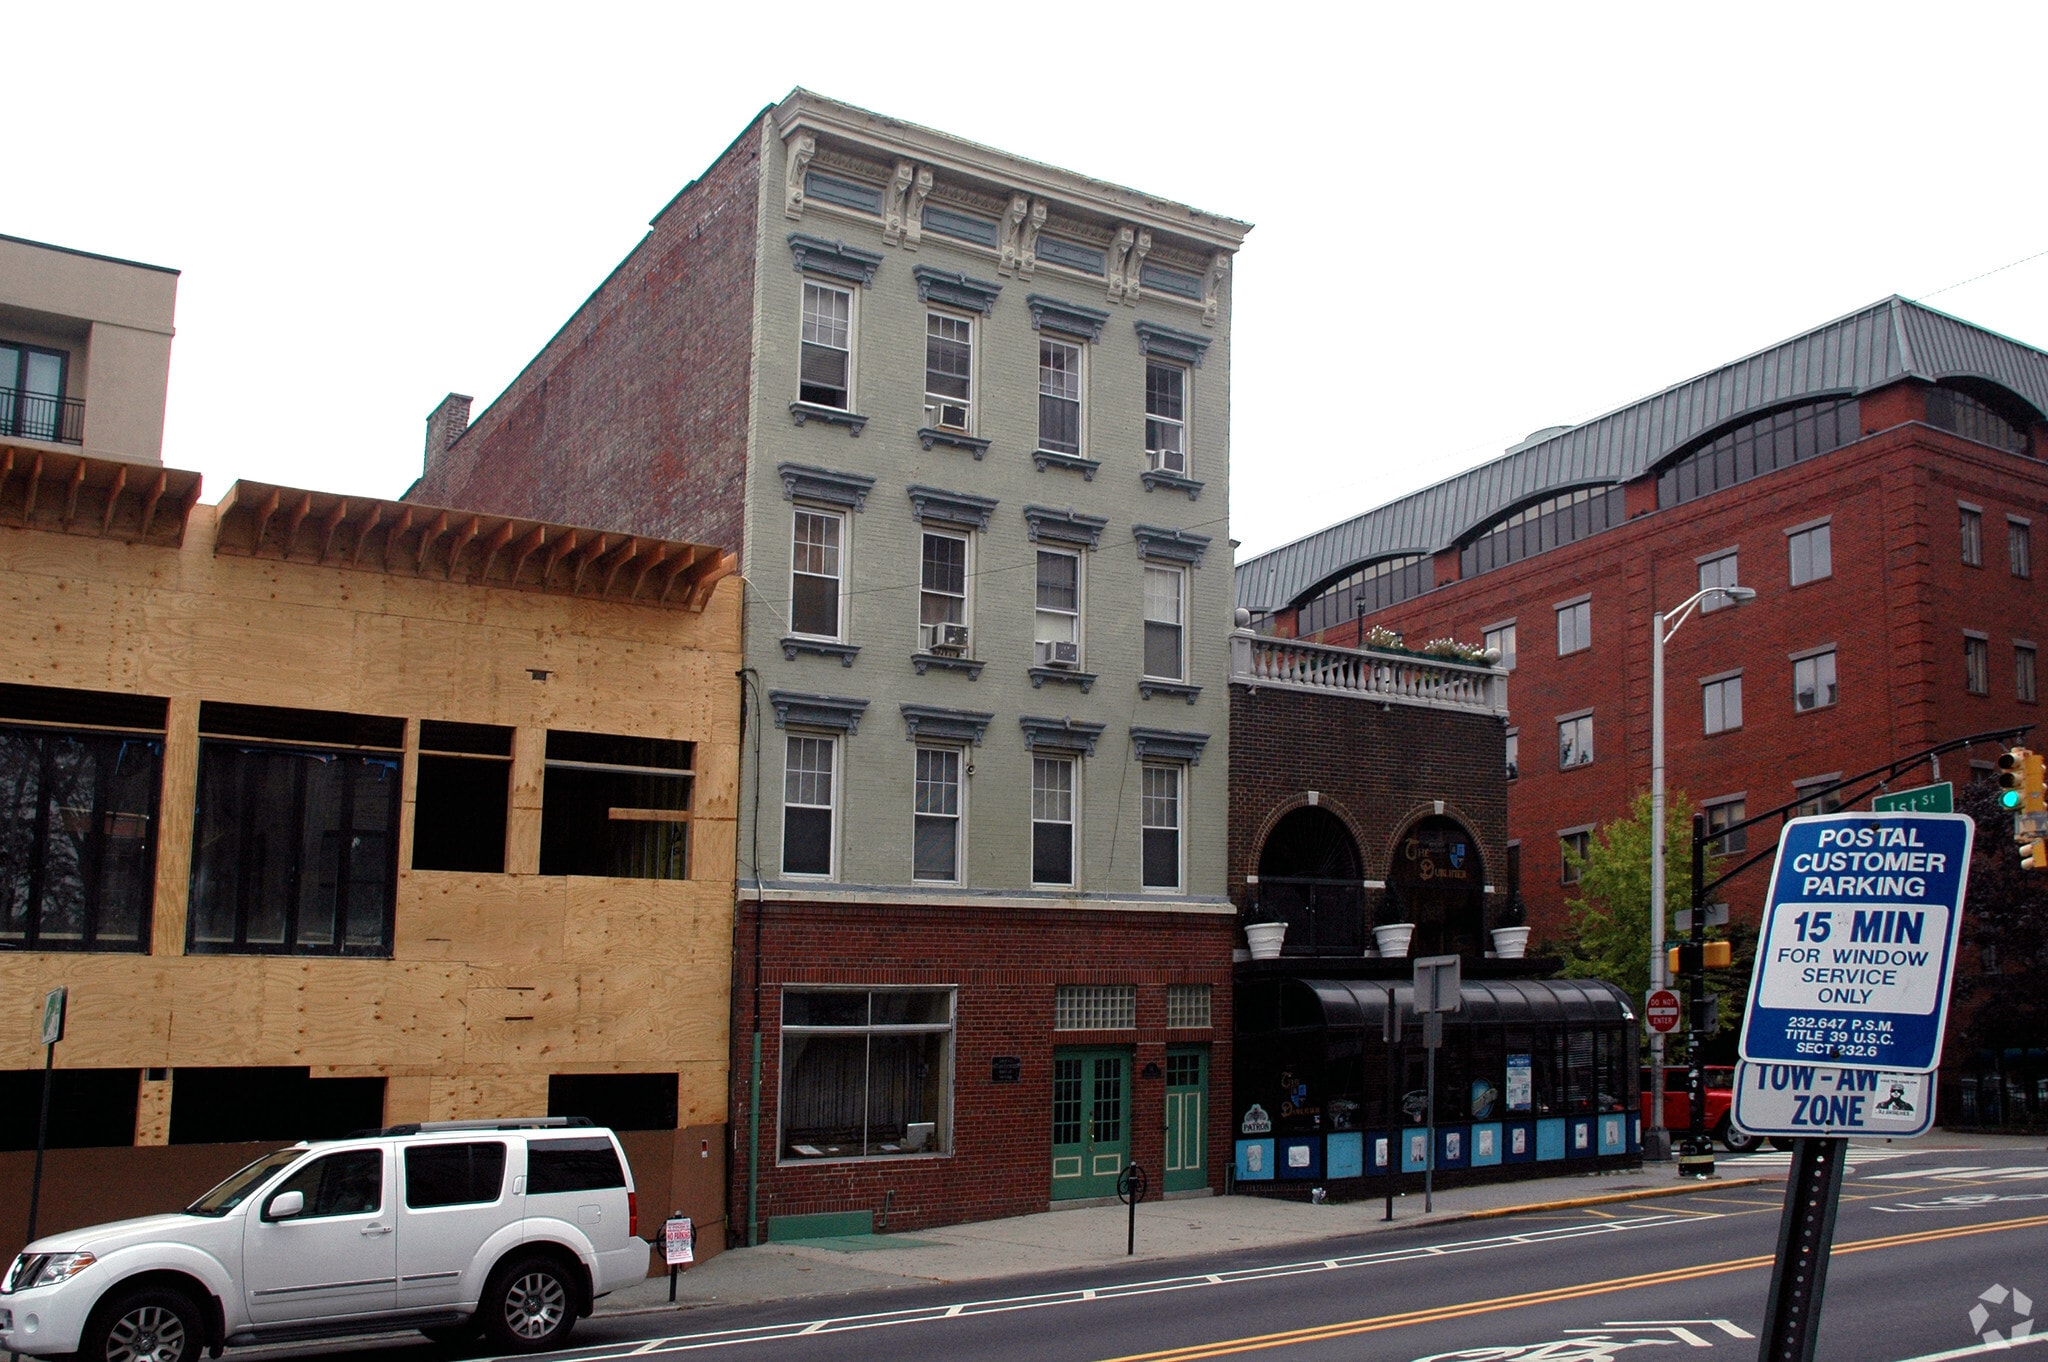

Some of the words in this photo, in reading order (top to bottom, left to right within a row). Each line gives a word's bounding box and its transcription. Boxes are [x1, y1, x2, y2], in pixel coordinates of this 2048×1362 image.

[1889, 798, 1917, 812] 1st
[1921, 794, 1935, 806] St
[1818, 827, 1925, 848] POSTAL
[1792, 852, 1947, 873] CUSTOMER
[1802, 876, 1926, 897] PARKING
[1794, 911, 1833, 943] 15
[1849, 910, 1925, 945] MIN
[1777, 948, 1821, 964] FOR
[1832, 948, 1929, 967] WINDOW
[1801, 967, 1897, 986] SERVICE
[1650, 998, 1660, 1006] DO
[1662, 998, 1675, 1006] NOT
[1817, 987, 1873, 1004] ONLY
[1653, 1016, 1673, 1025] ENTER
[1787, 1016, 1847, 1030] 232.647
[1851, 1019, 1894, 1032] P.S.M.
[1784, 1028, 1825, 1041] TITLE
[1829, 1031, 1848, 1043] 39
[1853, 1032, 1895, 1045] U.S.C.
[1796, 1042, 1834, 1055] SECT
[1837, 1044, 1878, 1057] 232.6
[1756, 1063, 1882, 1092] TOW-AW
[1791, 1094, 1866, 1127] ZONE
